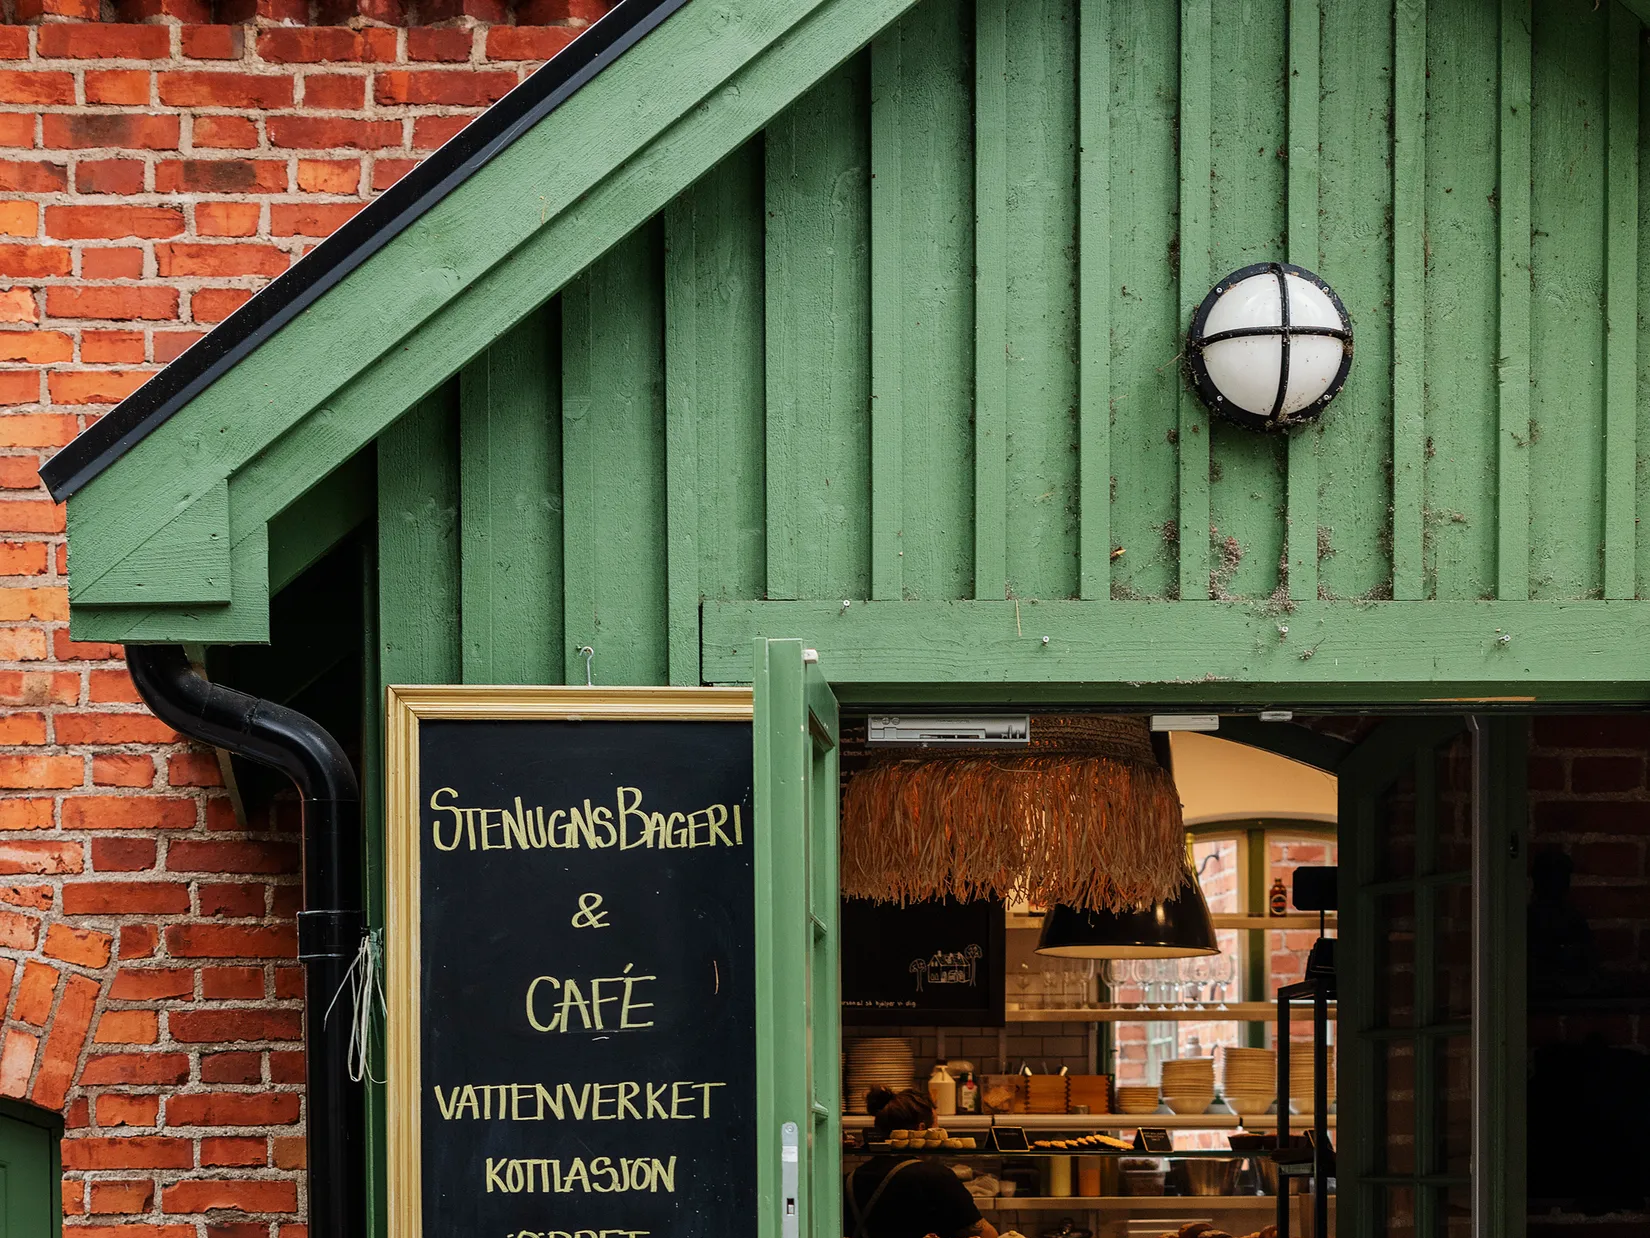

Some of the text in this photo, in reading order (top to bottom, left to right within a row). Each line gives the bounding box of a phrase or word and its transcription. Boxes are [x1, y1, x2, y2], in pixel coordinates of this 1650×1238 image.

[572, 894, 608, 927] &
[527, 964, 655, 1031] CAFÉ
[435, 1082, 724, 1120] VATTENVERKET
